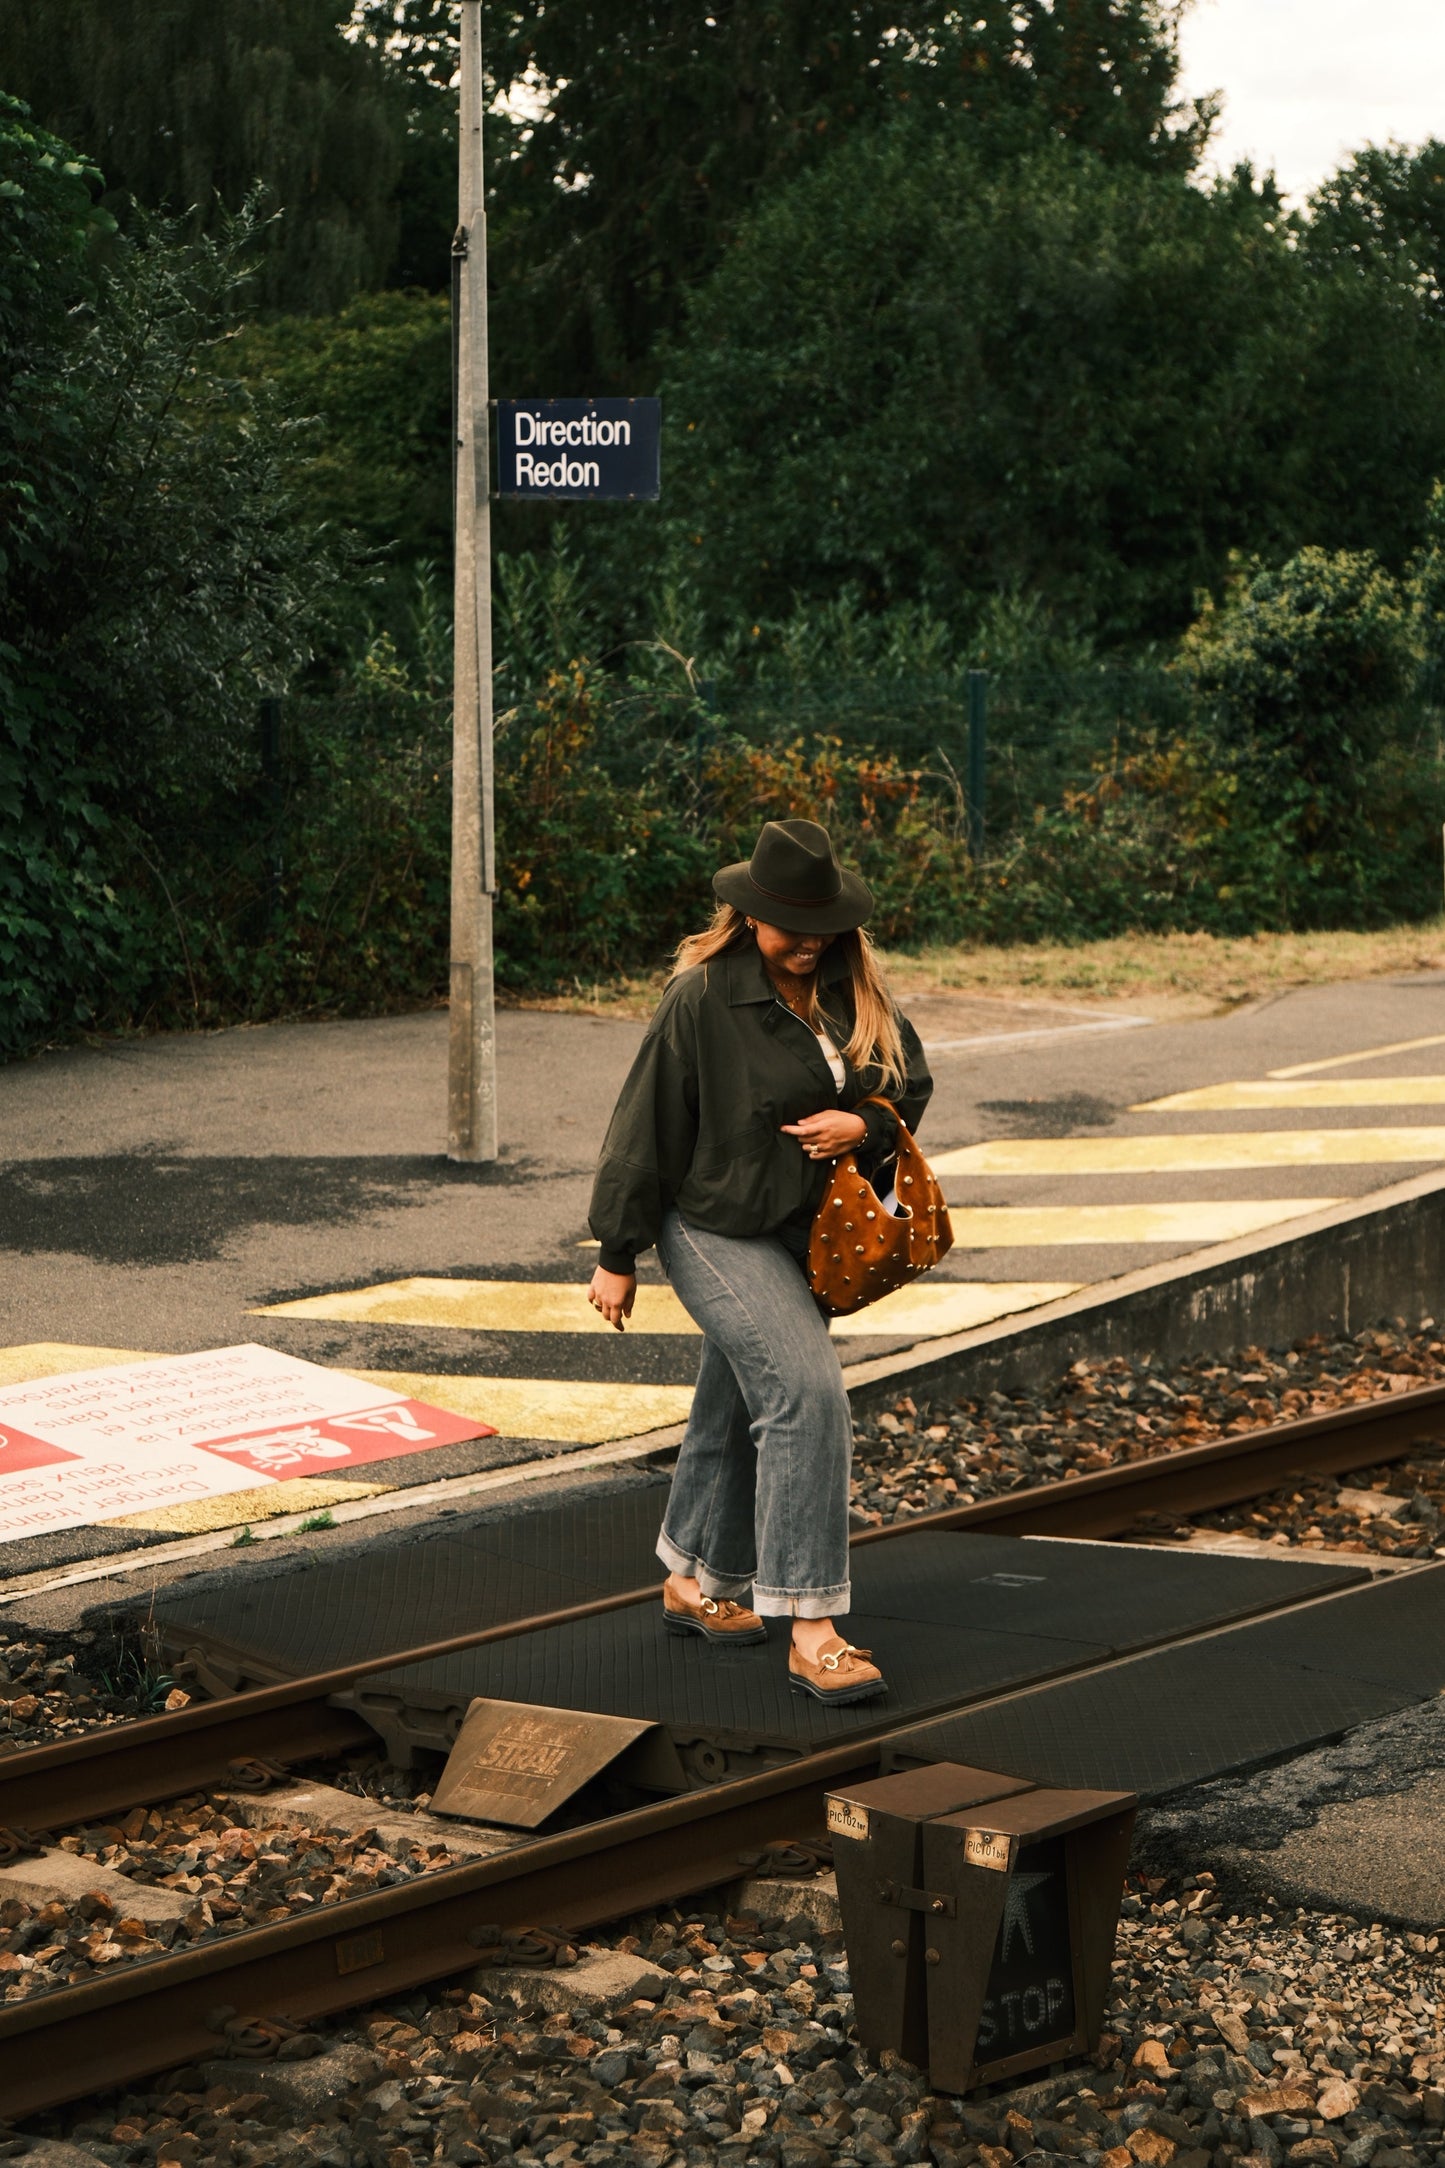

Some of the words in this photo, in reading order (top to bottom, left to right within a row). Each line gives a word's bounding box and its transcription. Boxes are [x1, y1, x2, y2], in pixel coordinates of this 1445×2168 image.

[515, 411, 631, 446] Direction
[515, 452, 600, 487] Redon
[129, 1369, 168, 1380] de
[168, 1356, 248, 1375] avant
[196, 1369, 245, 1381] les
[120, 1377, 193, 1394] deux
[178, 1373, 303, 1398] regardez
[45, 1390, 118, 1409] sens
[112, 1394, 183, 1413] bien
[128, 1389, 304, 1427] signalisation
[34, 1409, 109, 1429] dans
[168, 1402, 325, 1436] Respectez
[90, 1424, 126, 1437] et
[134, 1431, 173, 1444] la
[46, 1462, 126, 1483] deux
[67, 1463, 198, 1496] circulant
[977, 1978, 1065, 2046] STOP
